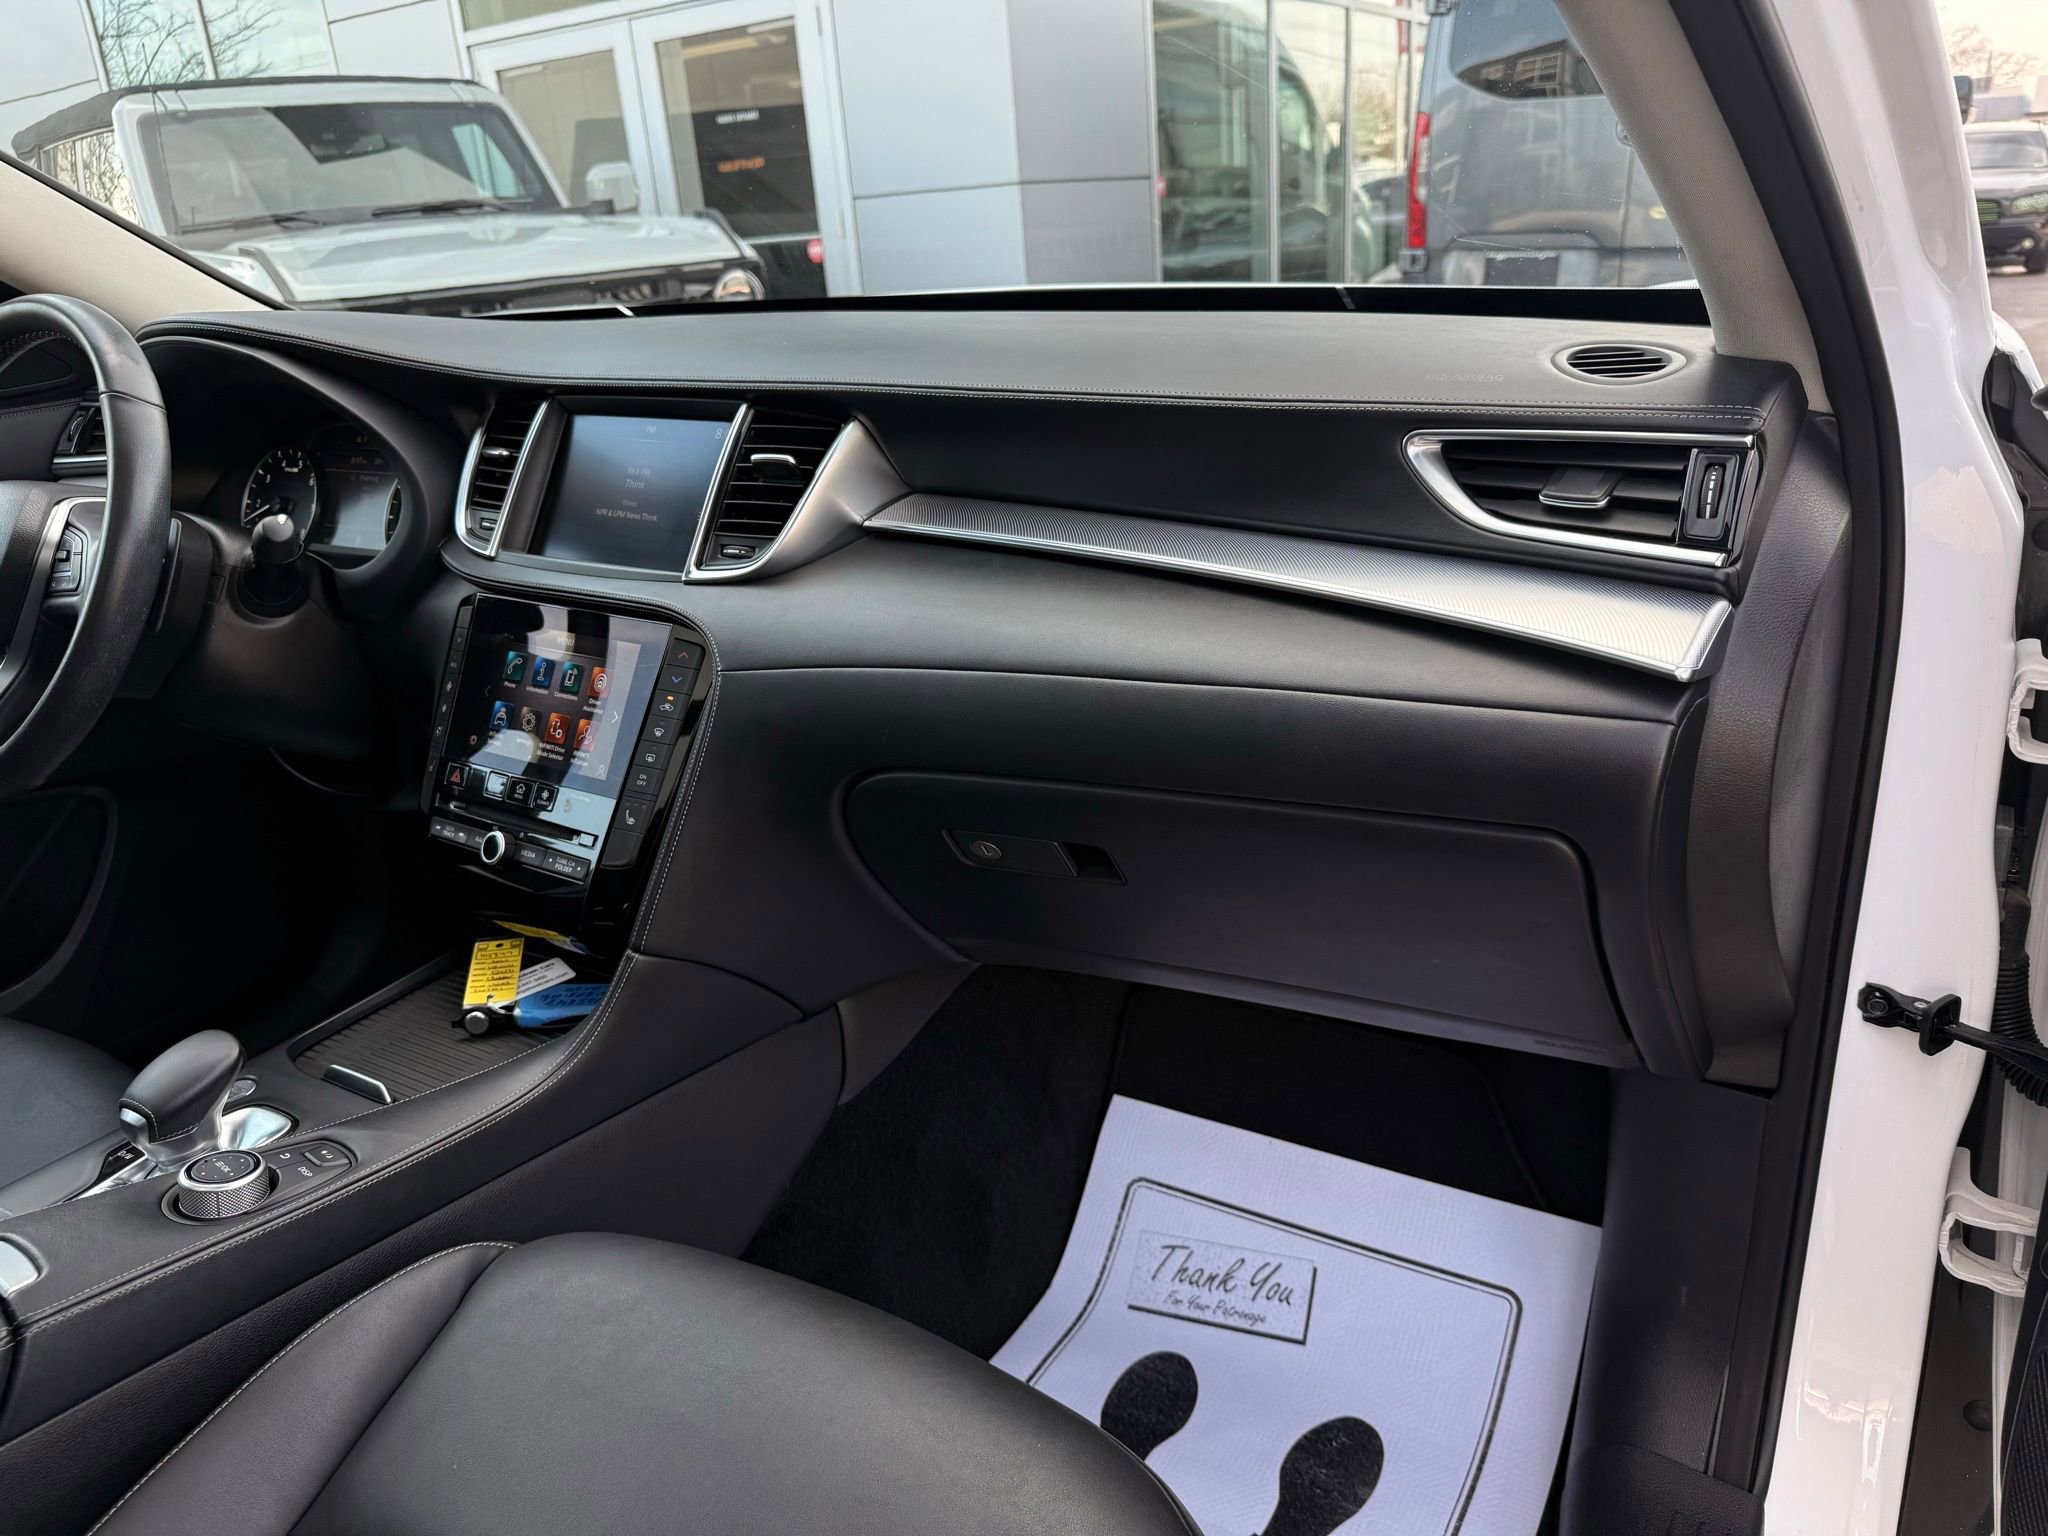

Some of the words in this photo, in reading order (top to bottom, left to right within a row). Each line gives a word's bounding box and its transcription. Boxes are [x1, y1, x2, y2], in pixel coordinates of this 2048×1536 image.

[625, 479, 646, 488] Think
[636, 779, 647, 787] OFF
[521, 849, 536, 858] MEDIA
[555, 863, 573, 873] FOLDER
[298, 1166, 313, 1177] DISP
[1152, 1245, 1246, 1293] Thank
[1249, 1262, 1293, 1306] You
[1163, 1290, 1183, 1305] For
[1187, 1295, 1210, 1313] Your
[1213, 1300, 1267, 1327] Patronage
